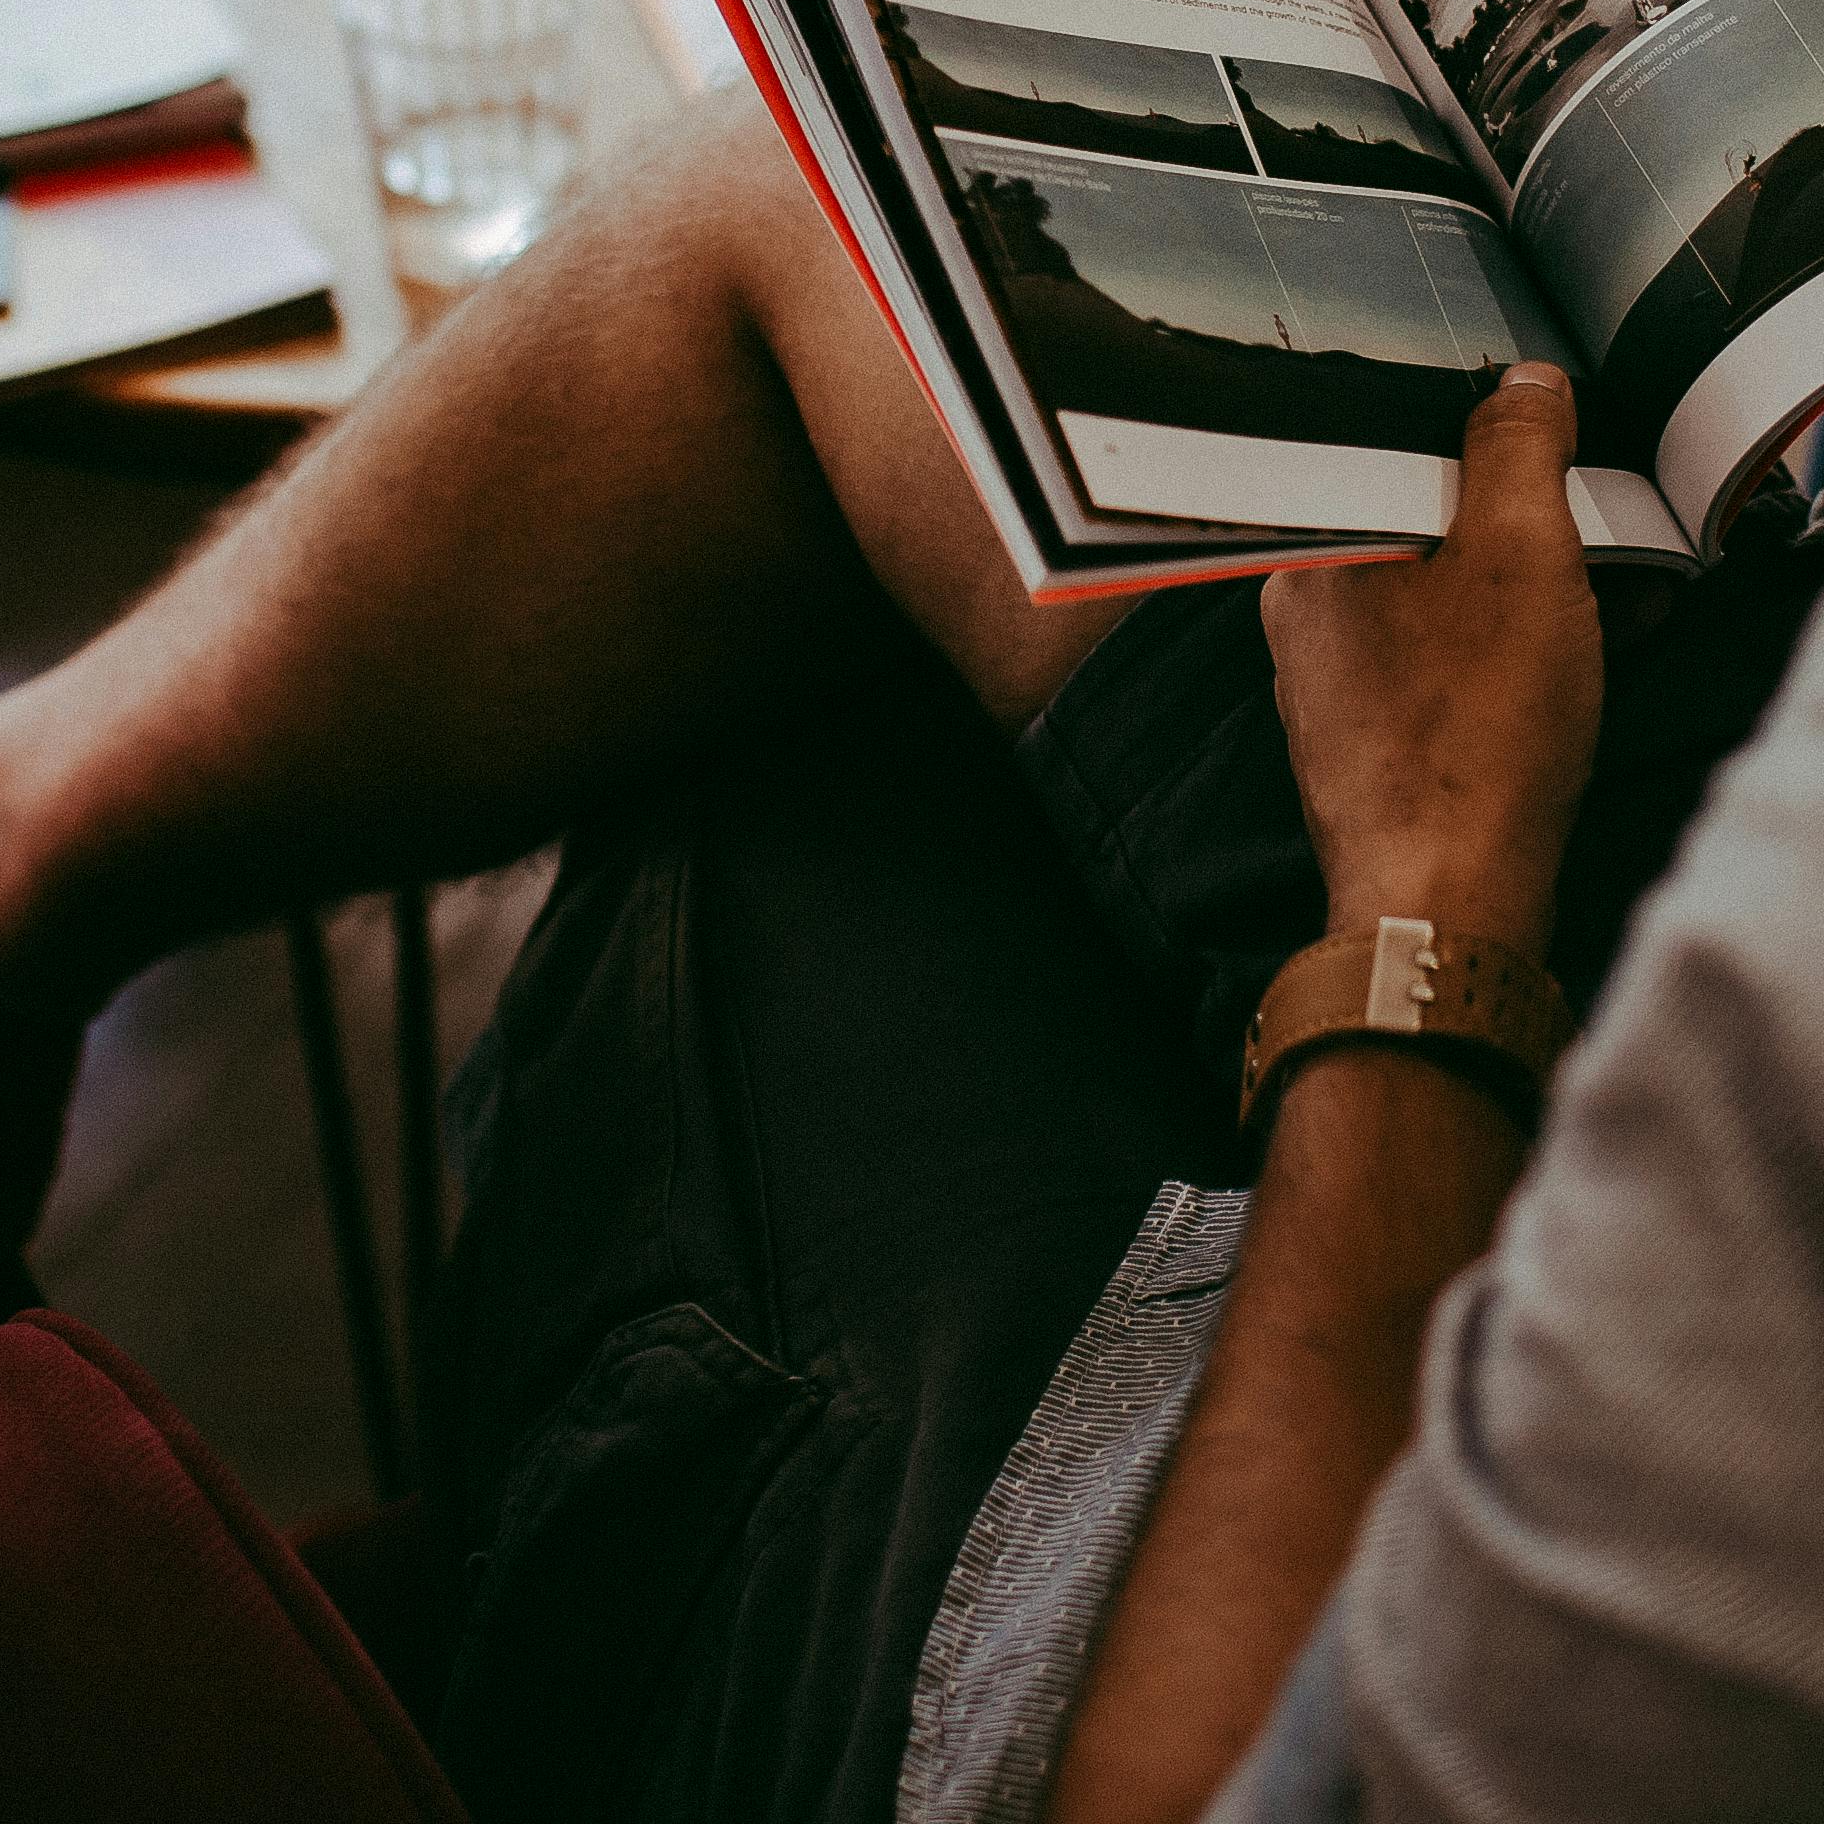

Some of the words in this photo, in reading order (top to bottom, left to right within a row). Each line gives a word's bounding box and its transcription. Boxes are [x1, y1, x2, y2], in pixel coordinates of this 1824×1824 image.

[1230, 5, 1247, 14] and
[1248, 7, 1263, 16] the
[1265, 10, 1296, 20] growth
[1298, 15, 1306, 23] of
[1605, 42, 1667, 96] revestimento
[1667, 33, 1681, 46] da
[1682, 11, 1715, 37] malha
[1614, 86, 1634, 108] com
[1634, 56, 1673, 93] plástico
[1674, 14, 1740, 60] transparente
[1328, 214, 1344, 224] cm
